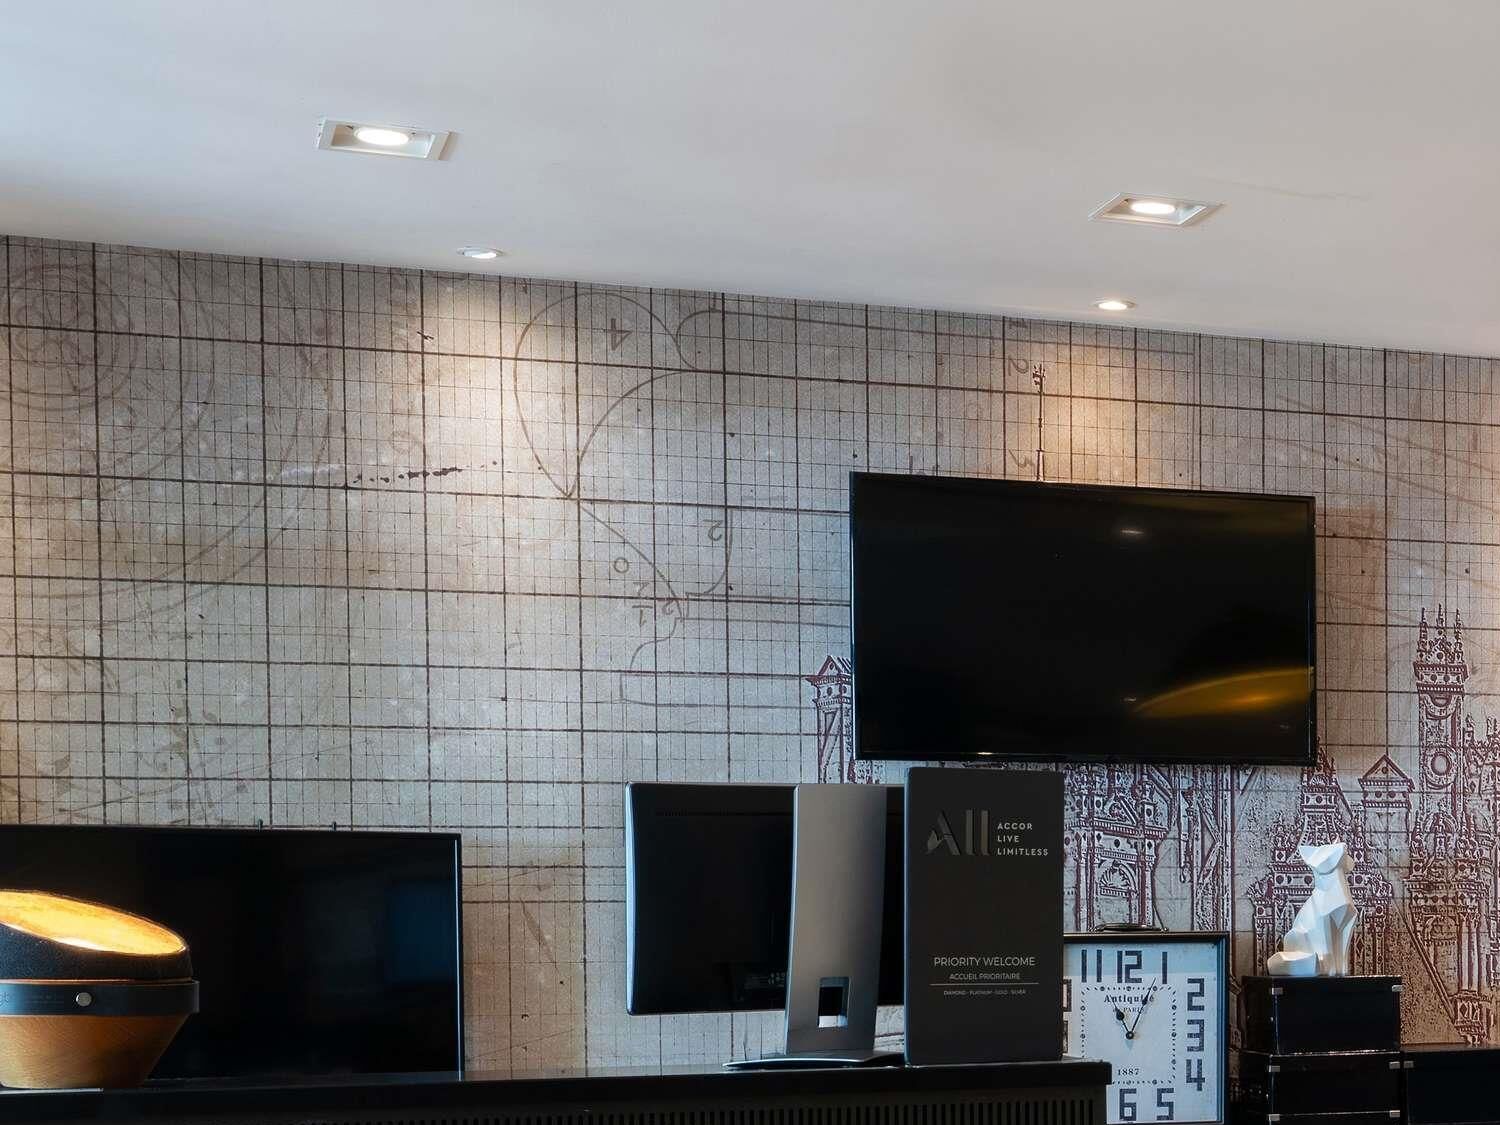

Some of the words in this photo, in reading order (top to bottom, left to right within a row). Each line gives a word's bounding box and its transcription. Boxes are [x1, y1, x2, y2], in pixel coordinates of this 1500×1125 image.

[997, 822, 1033, 830] ACCOR
[997, 835, 1020, 843] LIVE
[997, 848, 1049, 856] LIMITLESS
[934, 957, 980, 966] PRIORITY
[982, 956, 1036, 966] WELCOME
[1117, 950, 1143, 984] 12
[1161, 951, 1168, 985] 1
[949, 973, 977, 981] ACCUEIL
[1187, 978, 1205, 1011] 2
[1187, 1019, 1204, 1052] 3
[1117, 1068, 1140, 1076] 1887
[1186, 1059, 1205, 1091] 4
[1119, 1088, 1136, 1121] 6
[1156, 1087, 1175, 1121] 5
